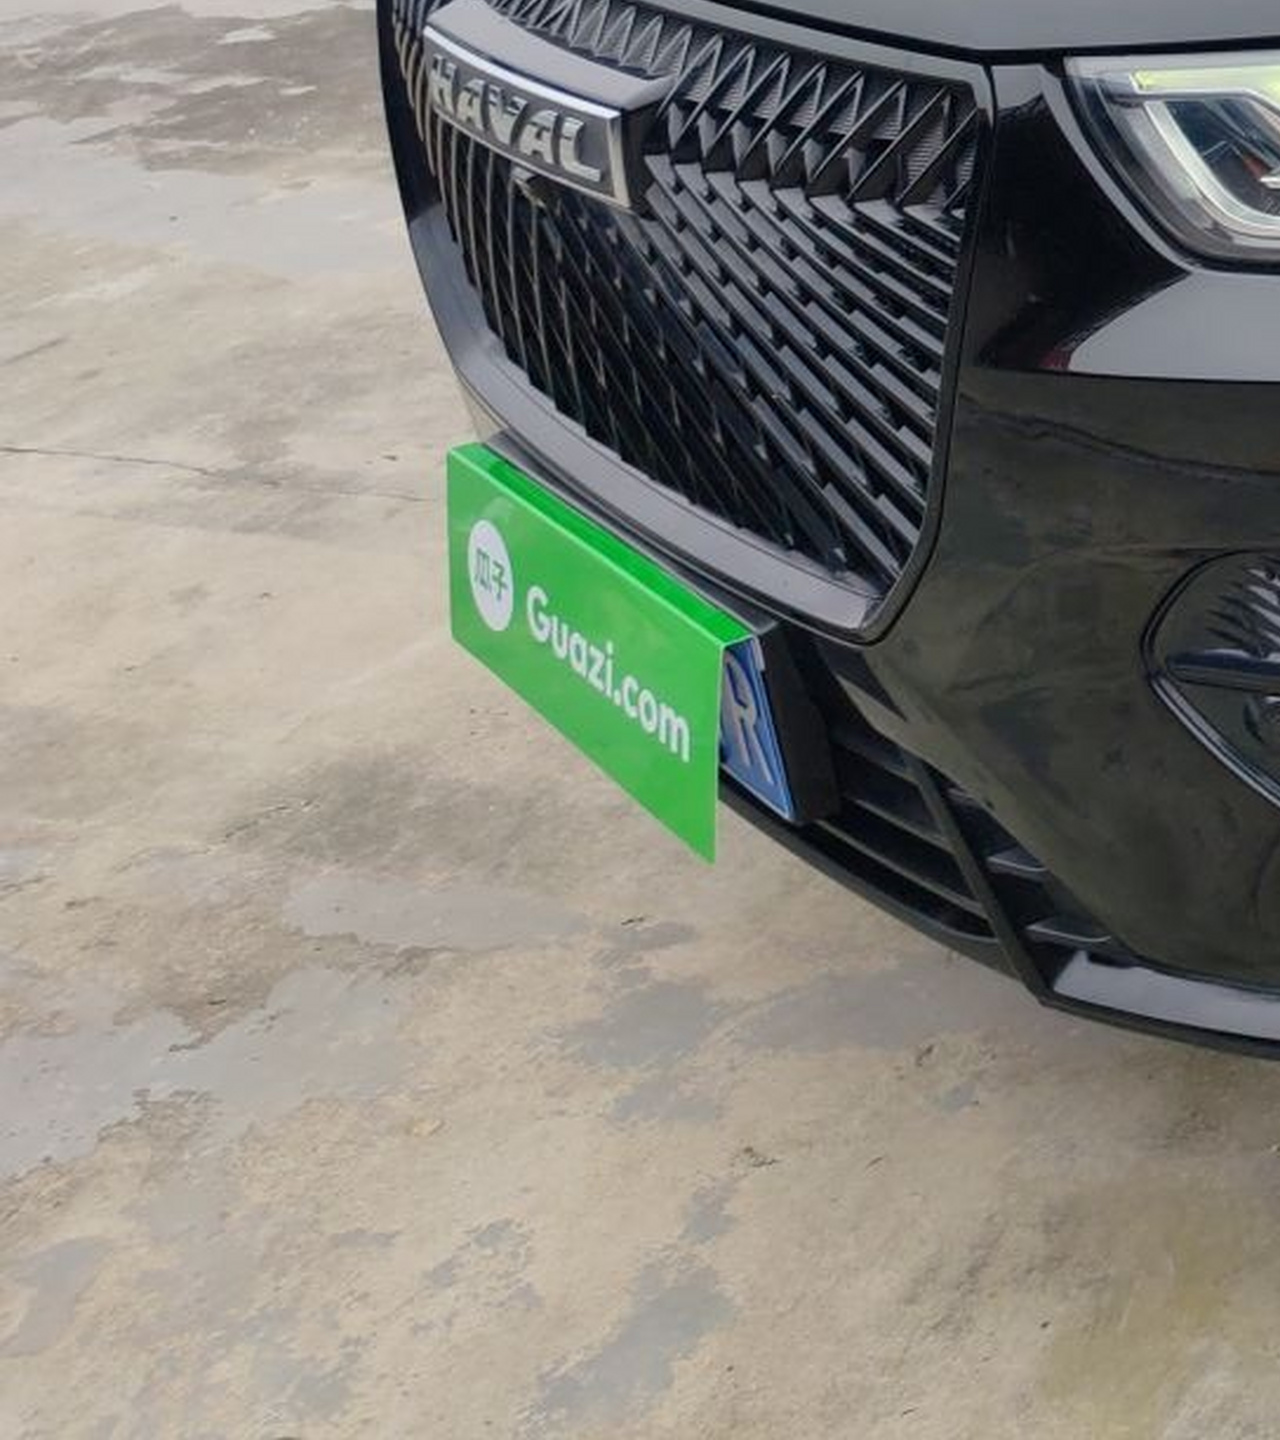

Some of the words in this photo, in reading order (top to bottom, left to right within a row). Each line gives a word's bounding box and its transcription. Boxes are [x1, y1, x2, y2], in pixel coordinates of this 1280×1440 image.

[430, 53, 601, 183] HAVAL
[475, 547, 509, 603] 瓜子
[526, 584, 690, 764] Guazi.com
